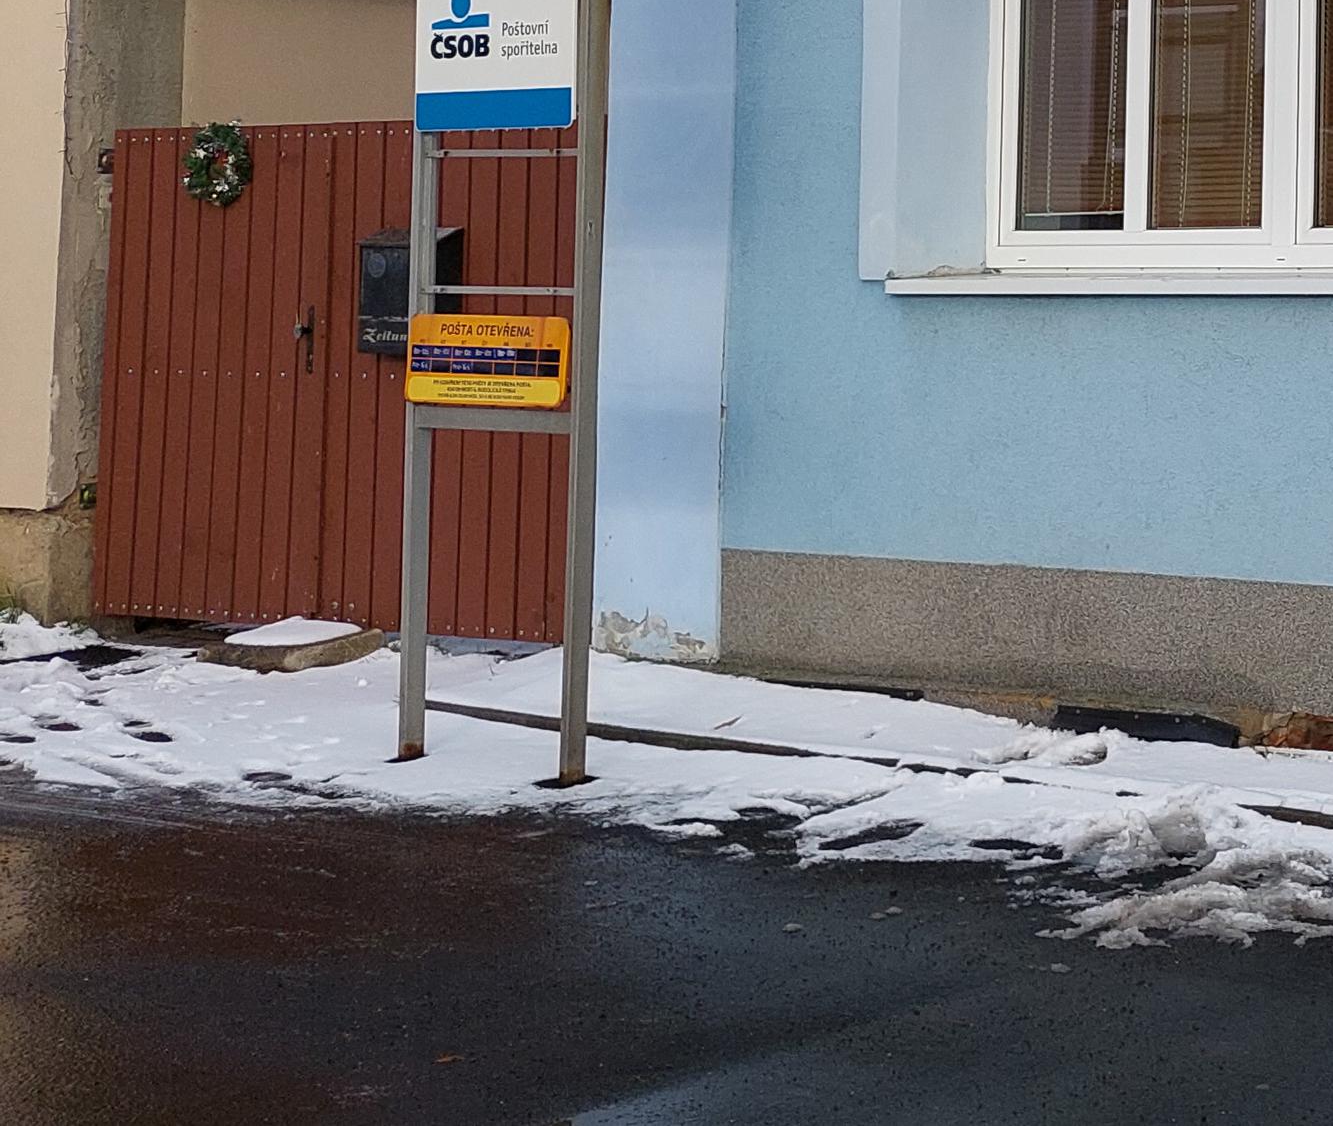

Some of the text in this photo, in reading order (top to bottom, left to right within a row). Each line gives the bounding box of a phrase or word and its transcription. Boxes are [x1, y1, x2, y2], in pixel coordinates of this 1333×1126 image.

[501, 19, 549, 37] Poštovní
[430, 32, 490, 60] ČSOB
[501, 38, 558, 61] spořitelna
[362, 328, 408, 343] Zeitun
[440, 321, 535, 338] POŠTA OTEVŘENA:
